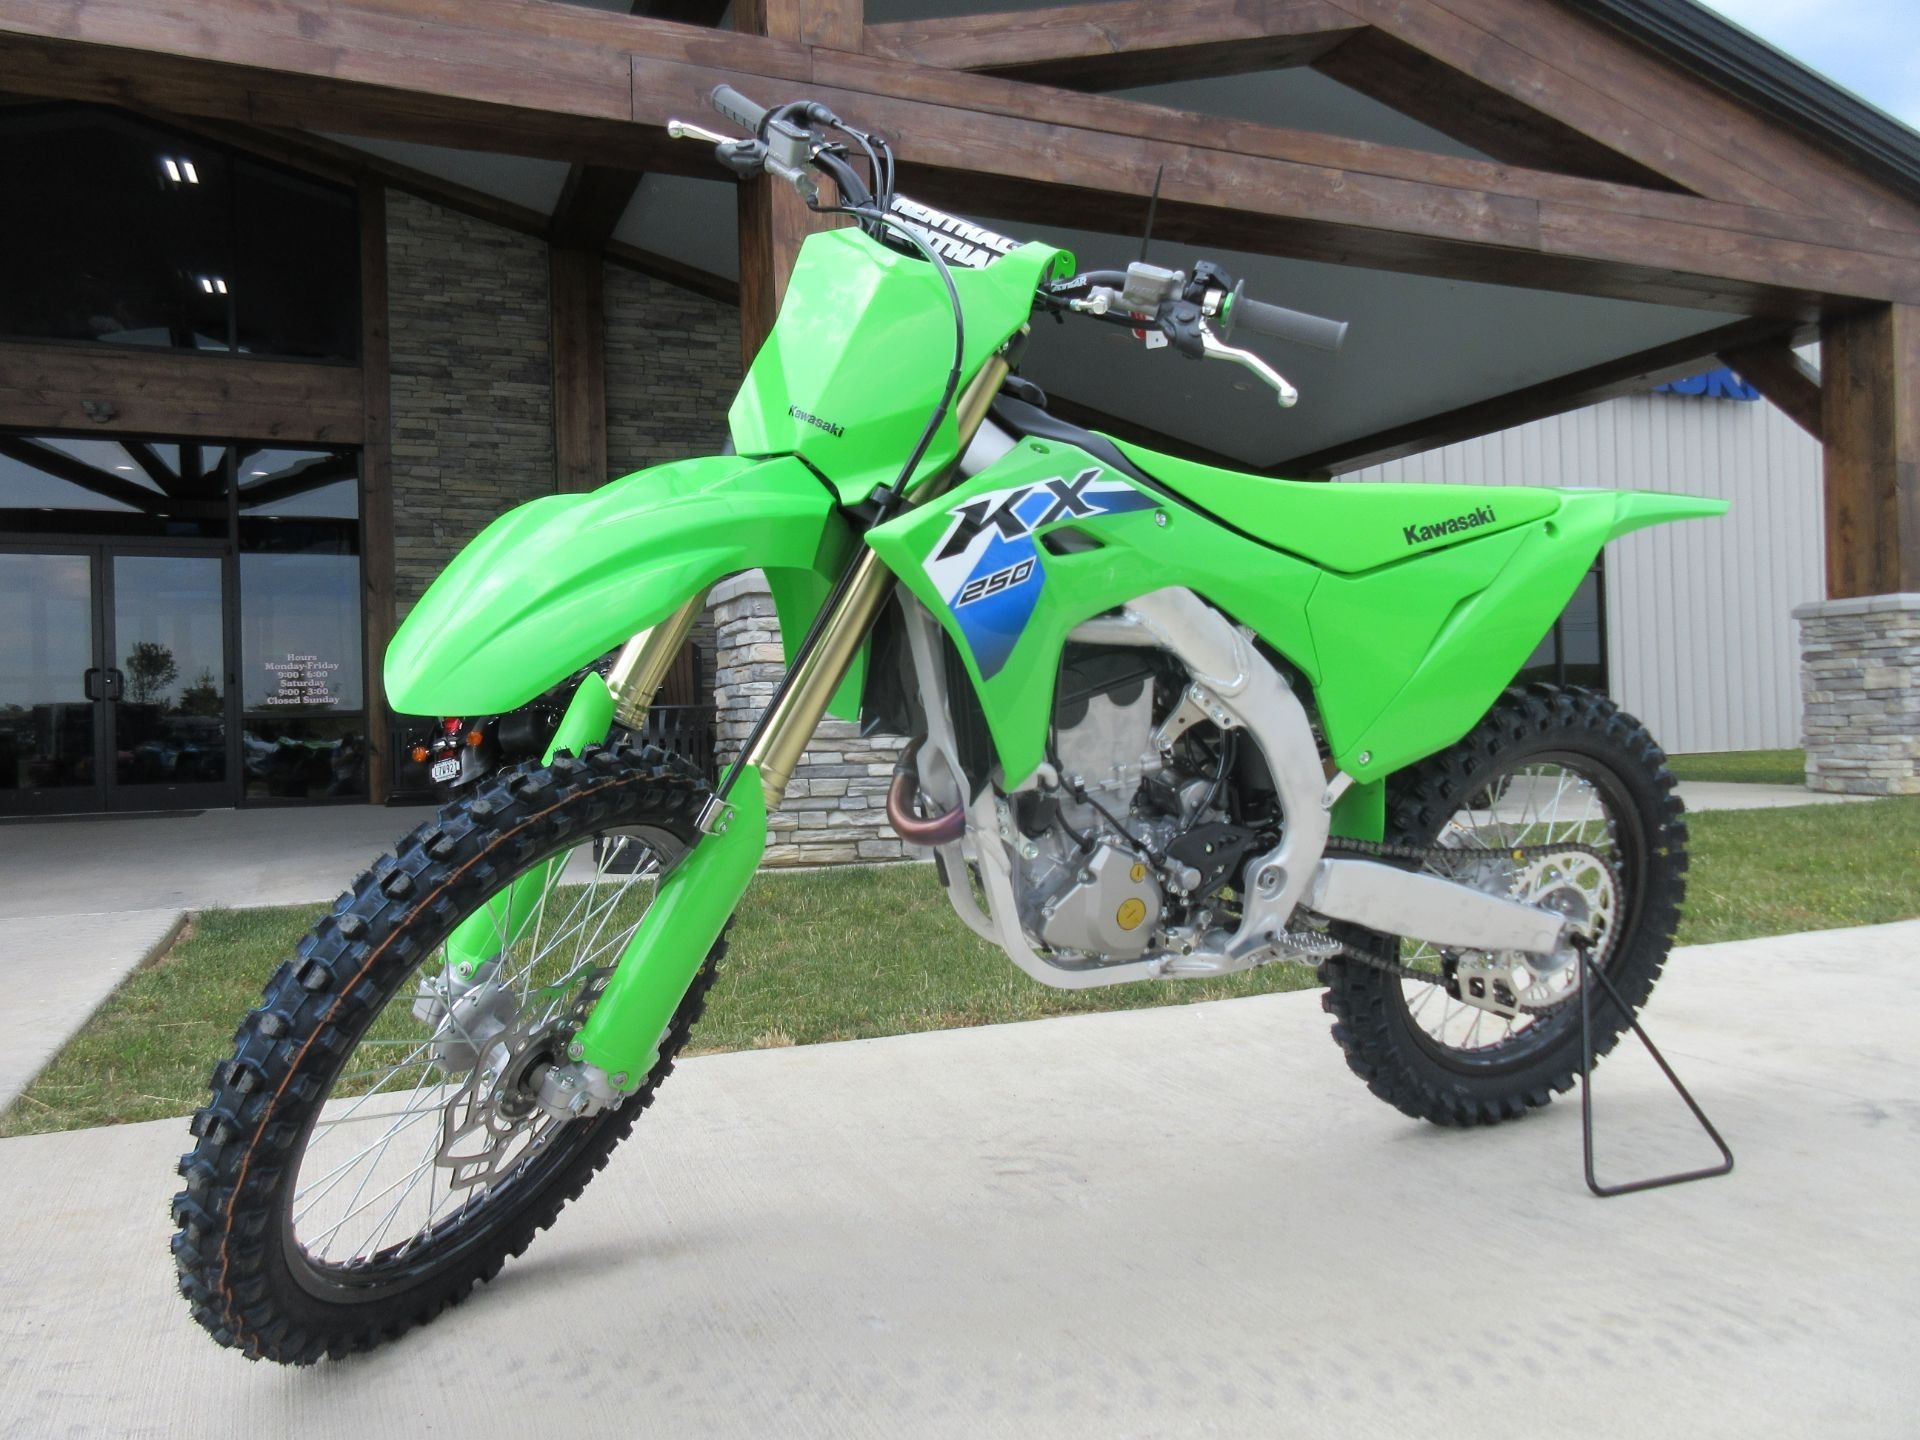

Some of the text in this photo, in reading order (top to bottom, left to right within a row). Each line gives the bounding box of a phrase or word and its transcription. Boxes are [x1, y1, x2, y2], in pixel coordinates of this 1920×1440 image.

[788, 405, 845, 438] Kawasaki
[934, 468, 1102, 562] KX
[1402, 504, 1496, 545] Kawasaki
[957, 556, 1036, 607] 250
[287, 653, 317, 661] Hours
[265, 662, 339, 671] Monday-Friday
[278, 671, 299, 679] 9:00
[306, 670, 328, 678] 6:00
[280, 679, 326, 688] Saturday
[278, 688, 300, 696] 9:00
[306, 688, 329, 696] 3:00
[267, 695, 340, 705] Closed Sunday
